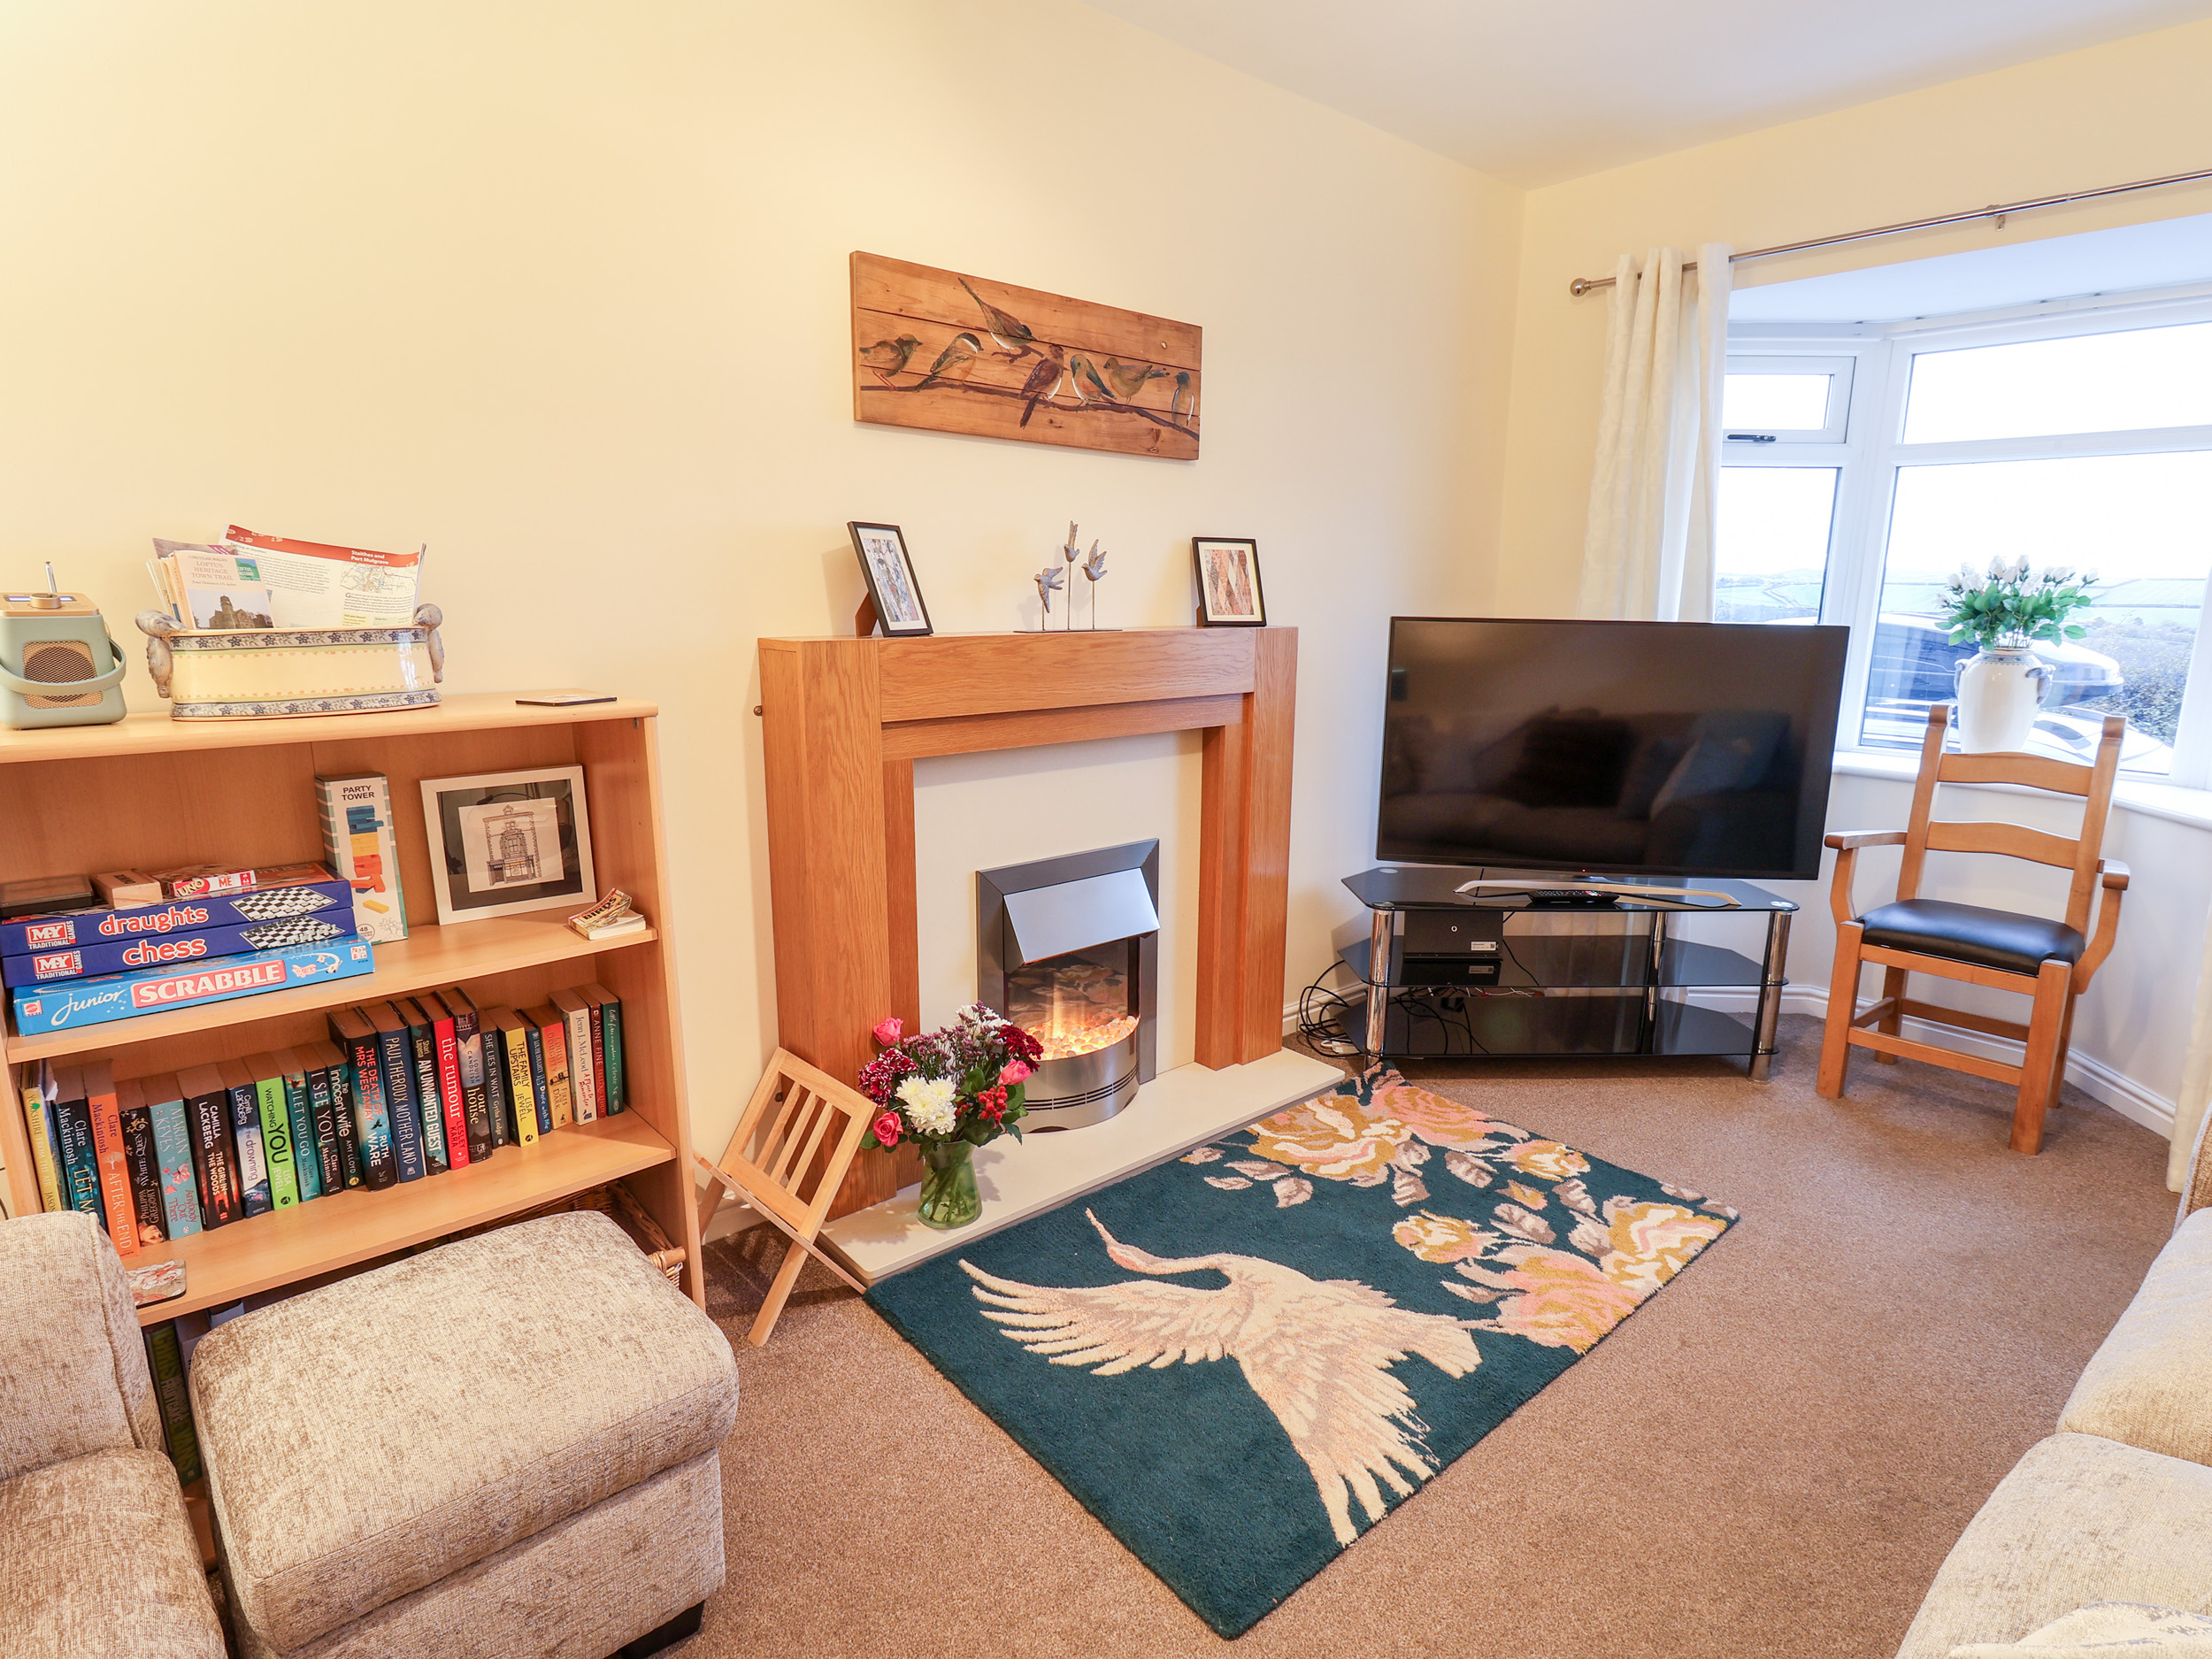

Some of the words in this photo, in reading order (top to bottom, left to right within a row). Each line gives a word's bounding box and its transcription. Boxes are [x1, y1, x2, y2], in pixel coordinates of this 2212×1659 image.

[342, 785, 372, 794] PARTY
[342, 791, 375, 801] TOWER
[177, 878, 205, 896] UNO
[219, 876, 232, 887] ME
[582, 896, 618, 920] BIRDS
[32, 925, 63, 941] MY
[66, 920, 75, 940] GAMES
[99, 906, 209, 936] draughts
[28, 940, 70, 949] TRADITIONAL
[123, 939, 207, 965] chess
[39, 955, 70, 971] MY
[73, 950, 82, 970] GAMES
[35, 969, 77, 979] TRADITIONAL
[50, 986, 128, 1026] junior
[139, 964, 280, 1004] SCRABBLE
[576, 1017, 585, 1033] Jenn
[355, 1046, 365, 1067] MRS
[365, 1048, 377, 1068] THE
[386, 1037, 400, 1062] PAUL
[415, 1039, 425, 1058] Lapena
[442, 1038, 455, 1062] the
[486, 1048, 496, 1067] LIES
[516, 1041, 526, 1058] THE
[547, 1032, 557, 1072] DOUGHTY
[554, 1036, 564, 1064] LOUISE
[578, 1041, 589, 1072] McLeod
[418, 1060, 432, 1075] AN
[467, 1050, 476, 1084] CANDLISH
[509, 1048, 521, 1087] UPSTAIRS
[519, 1058, 531, 1087] FAMILY
[330, 1069, 346, 1112] innocent
[357, 1068, 374, 1121] WESTAWAY
[367, 1068, 380, 1102] DEATH
[388, 1060, 408, 1104] THEROUX
[445, 1064, 461, 1118] rumour
[490, 1080, 499, 1097] WAIT
[243, 1094, 253, 1114] Camilla
[265, 1087, 277, 1127] WATCHING
[293, 1096, 305, 1114] LET
[312, 1083, 330, 1108] SEE
[420, 1075, 439, 1122] UNWANTED
[467, 1087, 480, 1125] house
[477, 1093, 488, 1114] our
[515, 1094, 527, 1122] JEWELL
[524, 1096, 534, 1115] LISA
[373, 1102, 384, 1116] OF
[396, 1103, 414, 1140] MOTHER
[493, 1101, 502, 1119] Gytha
[74, 1120, 87, 1147] Clare
[92, 1104, 109, 1154] Mackintosh
[108, 1114, 119, 1137] Clare
[170, 1108, 189, 1154] MARIAN
[210, 1105, 221, 1139] CAMILLA
[296, 1118, 309, 1140] YOU
[317, 1110, 334, 1144] YOU
[336, 1111, 352, 1137] wife
[456, 1120, 465, 1148] LESLEY
[544, 1118, 550, 1129] Me
[58, 1108, 76, 1165] Mackintosh
[155, 1117, 174, 1153] KEYES
[268, 1124, 288, 1164] YOU
[379, 1134, 390, 1159] RUTH
[426, 1123, 442, 1151] GUEST
[449, 1126, 459, 1148] KARA
[216, 1152, 225, 1166] THE
[246, 1140, 260, 1181] drowning
[299, 1140, 311, 1156] GO
[367, 1132, 382, 1167] WARE
[401, 1141, 418, 1165] LAND
[35, 1137, 45, 1156] FROM
[43, 1173, 52, 1188] AIR
[207, 1152, 216, 1171] THE
[301, 1157, 311, 1187] Mackintosh
[321, 1147, 334, 1184] Mackintosh
[347, 1154, 357, 1174] LLOYD
[73, 1169, 93, 1194] LET
[210, 1171, 220, 1195] WOODS
[271, 1166, 284, 1194] JEWELL
[282, 1169, 293, 1186] LISA
[109, 1172, 125, 1210] AFTER
[140, 1189, 150, 1219] PHILIPPA
[147, 1188, 158, 1224] GREGORY
[168, 1197, 179, 1222] There
[178, 1203, 188, 1219] Out
[185, 1190, 200, 1224] Anybody
[117, 1210, 127, 1225] THE
[119, 1225, 132, 1248] END
